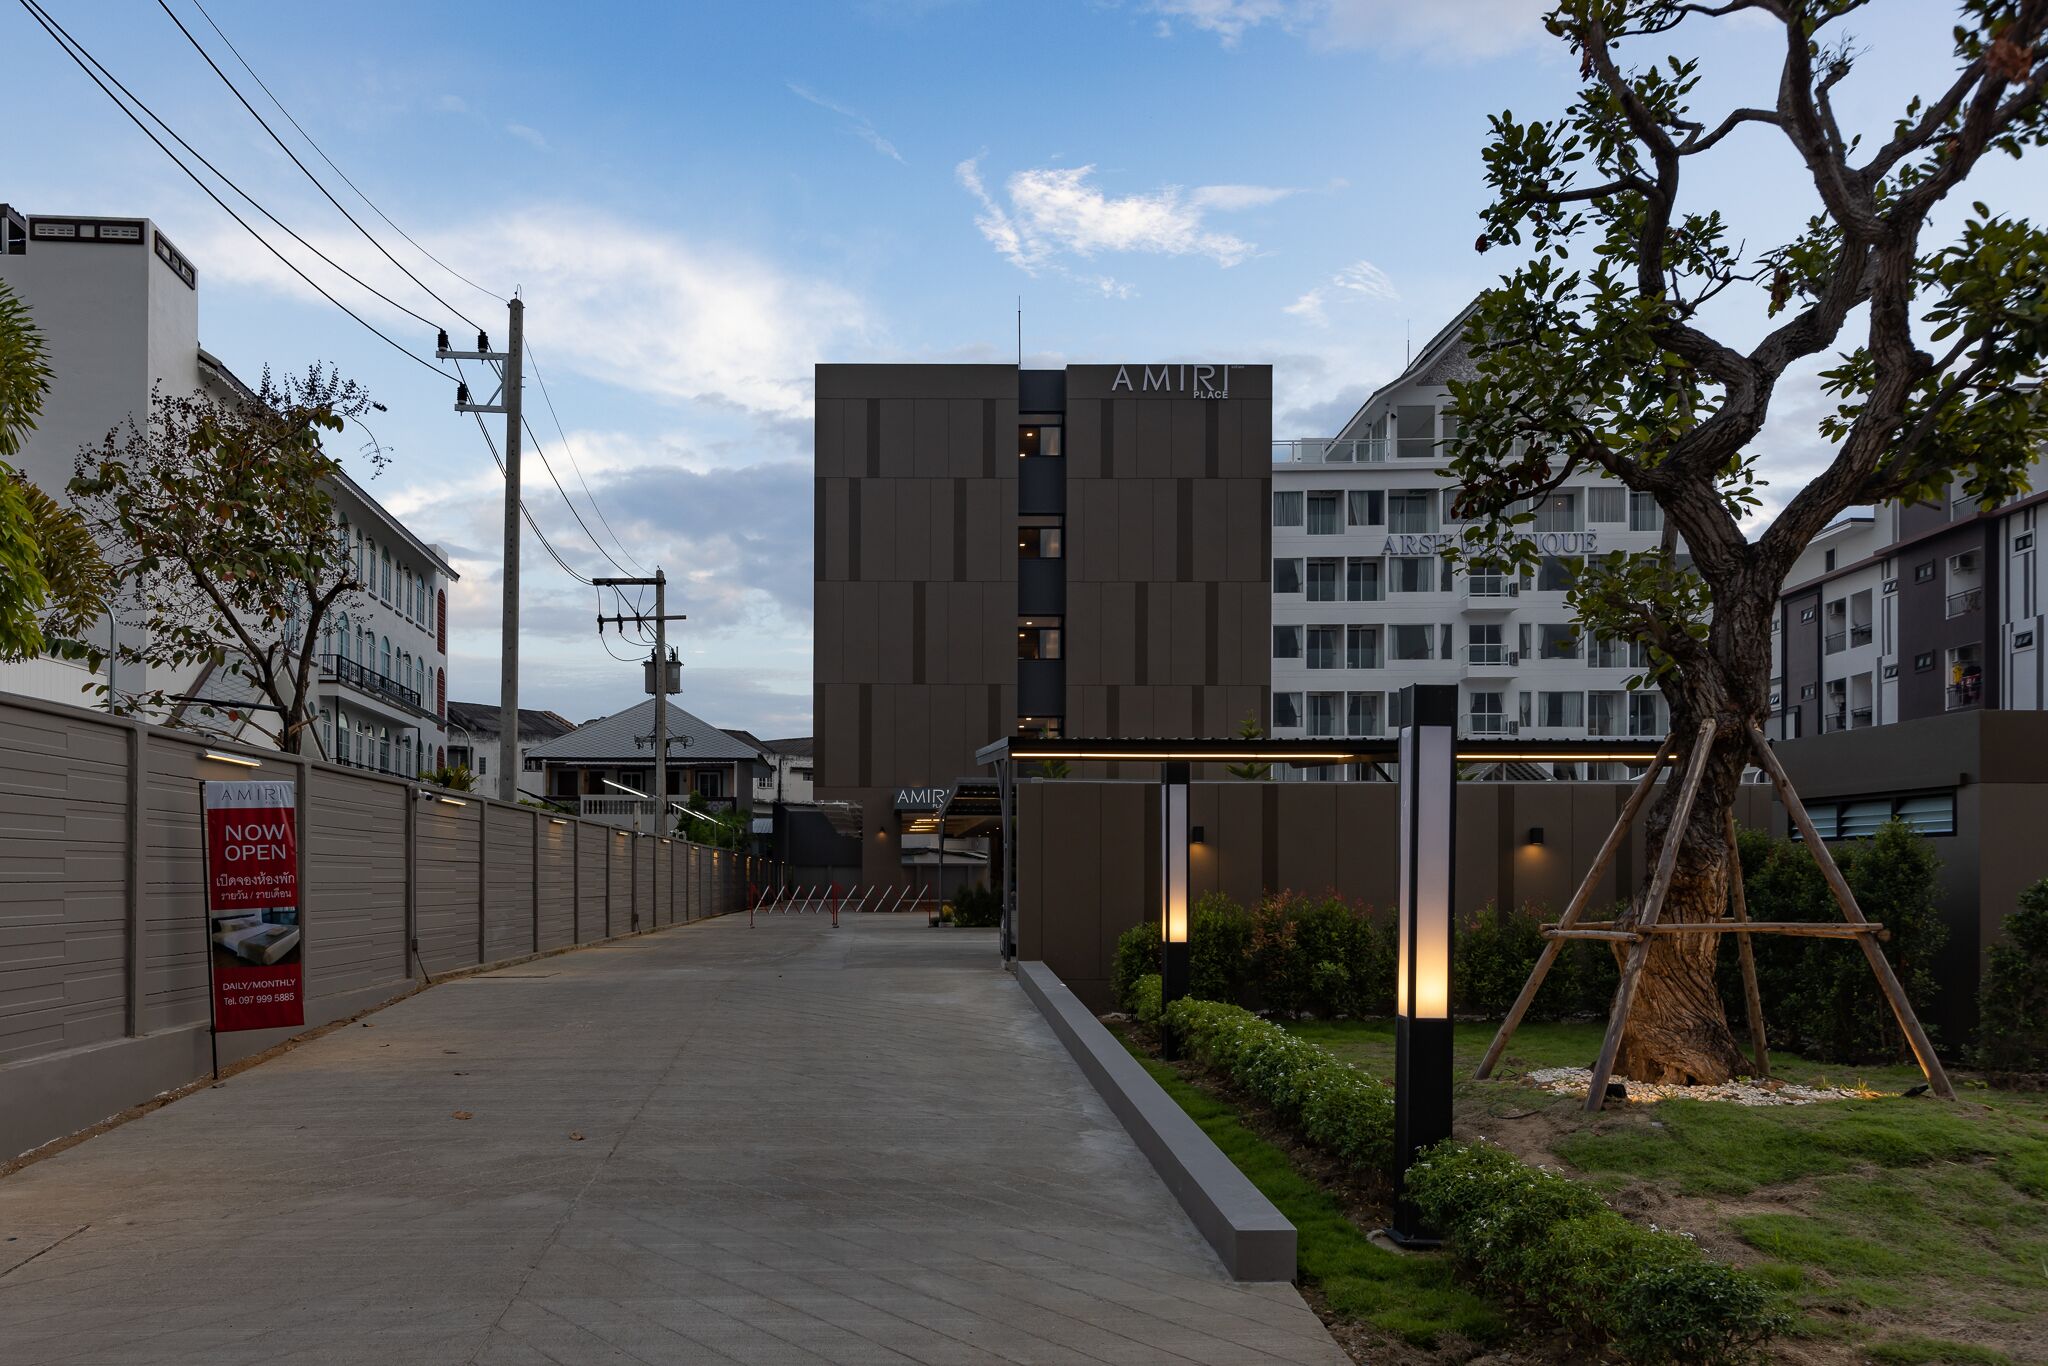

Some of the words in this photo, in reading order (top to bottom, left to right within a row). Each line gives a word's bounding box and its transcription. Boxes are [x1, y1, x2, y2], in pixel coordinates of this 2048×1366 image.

[1111, 364, 1229, 391] AMIRI
[1193, 390, 1229, 399] PLACE
[221, 788, 283, 801] AMIRI
[225, 823, 285, 841] NOW
[224, 844, 286, 861] OPEN
[216, 871, 295, 887] เปิดจองห้องพัก
[221, 890, 248, 901] รายวัน
[255, 888, 292, 900] รายเดือน
[222, 978, 296, 991] DAILY/MONTHLY
[223, 997, 237, 1006] Tel.
[238, 995, 254, 1005] 097
[256, 994, 273, 1004] 999
[274, 992, 295, 1002] 5885
